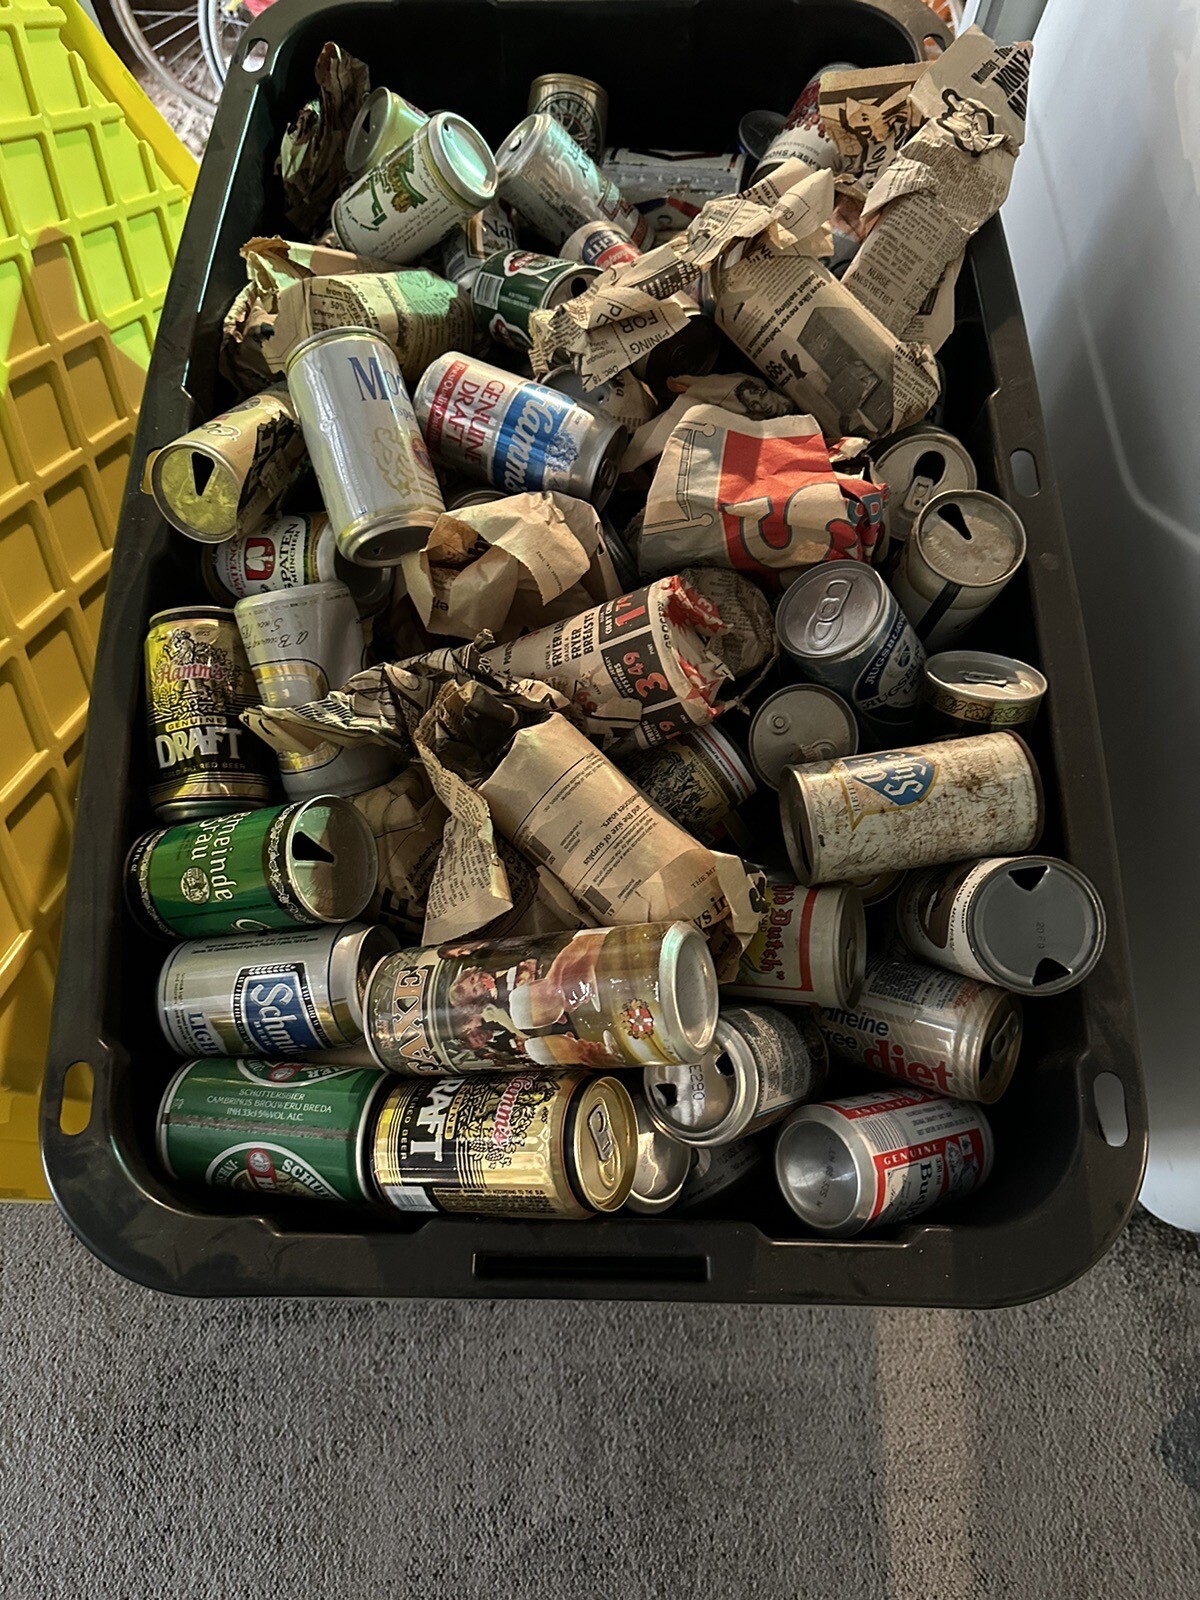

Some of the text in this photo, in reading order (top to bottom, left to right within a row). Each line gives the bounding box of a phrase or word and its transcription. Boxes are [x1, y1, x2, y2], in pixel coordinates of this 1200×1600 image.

[849, 270, 895, 306] ANESTHETIST
[866, 267, 890, 291] NURSE
[759, 277, 827, 352] Save like never before
[773, 288, 800, 319] selling
[617, 306, 658, 337] FOR
[449, 378, 482, 448] DRAFT
[470, 378, 506, 465] GENUINE
[280, 522, 298, 589] SPATEN
[583, 612, 596, 656] BREASTS
[657, 600, 672, 650] GROCERY
[551, 635, 563, 668] FRYER
[571, 627, 583, 660] FRYER
[615, 663, 634, 698] OYSTERS
[166, 715, 223, 730] GENUINE
[156, 727, 242, 769] DRAFT
[598, 809, 621, 832] soars.
[608, 820, 626, 837] size
[620, 811, 634, 826] the
[578, 838, 607, 867] surplus
[601, 832, 614, 845] of
[689, 875, 705, 890] THE
[392, 966, 442, 1075] FAXE
[863, 1041, 954, 1092] diet
[238, 1086, 305, 1102] SCHUTTERSBIER
[302, 1102, 332, 1114] BREDA
[286, 1111, 304, 1121] ALC
[410, 1079, 455, 1162] RAFT
[399, 1127, 409, 1161] BEER
[882, 1144, 940, 1167] GENUINE
